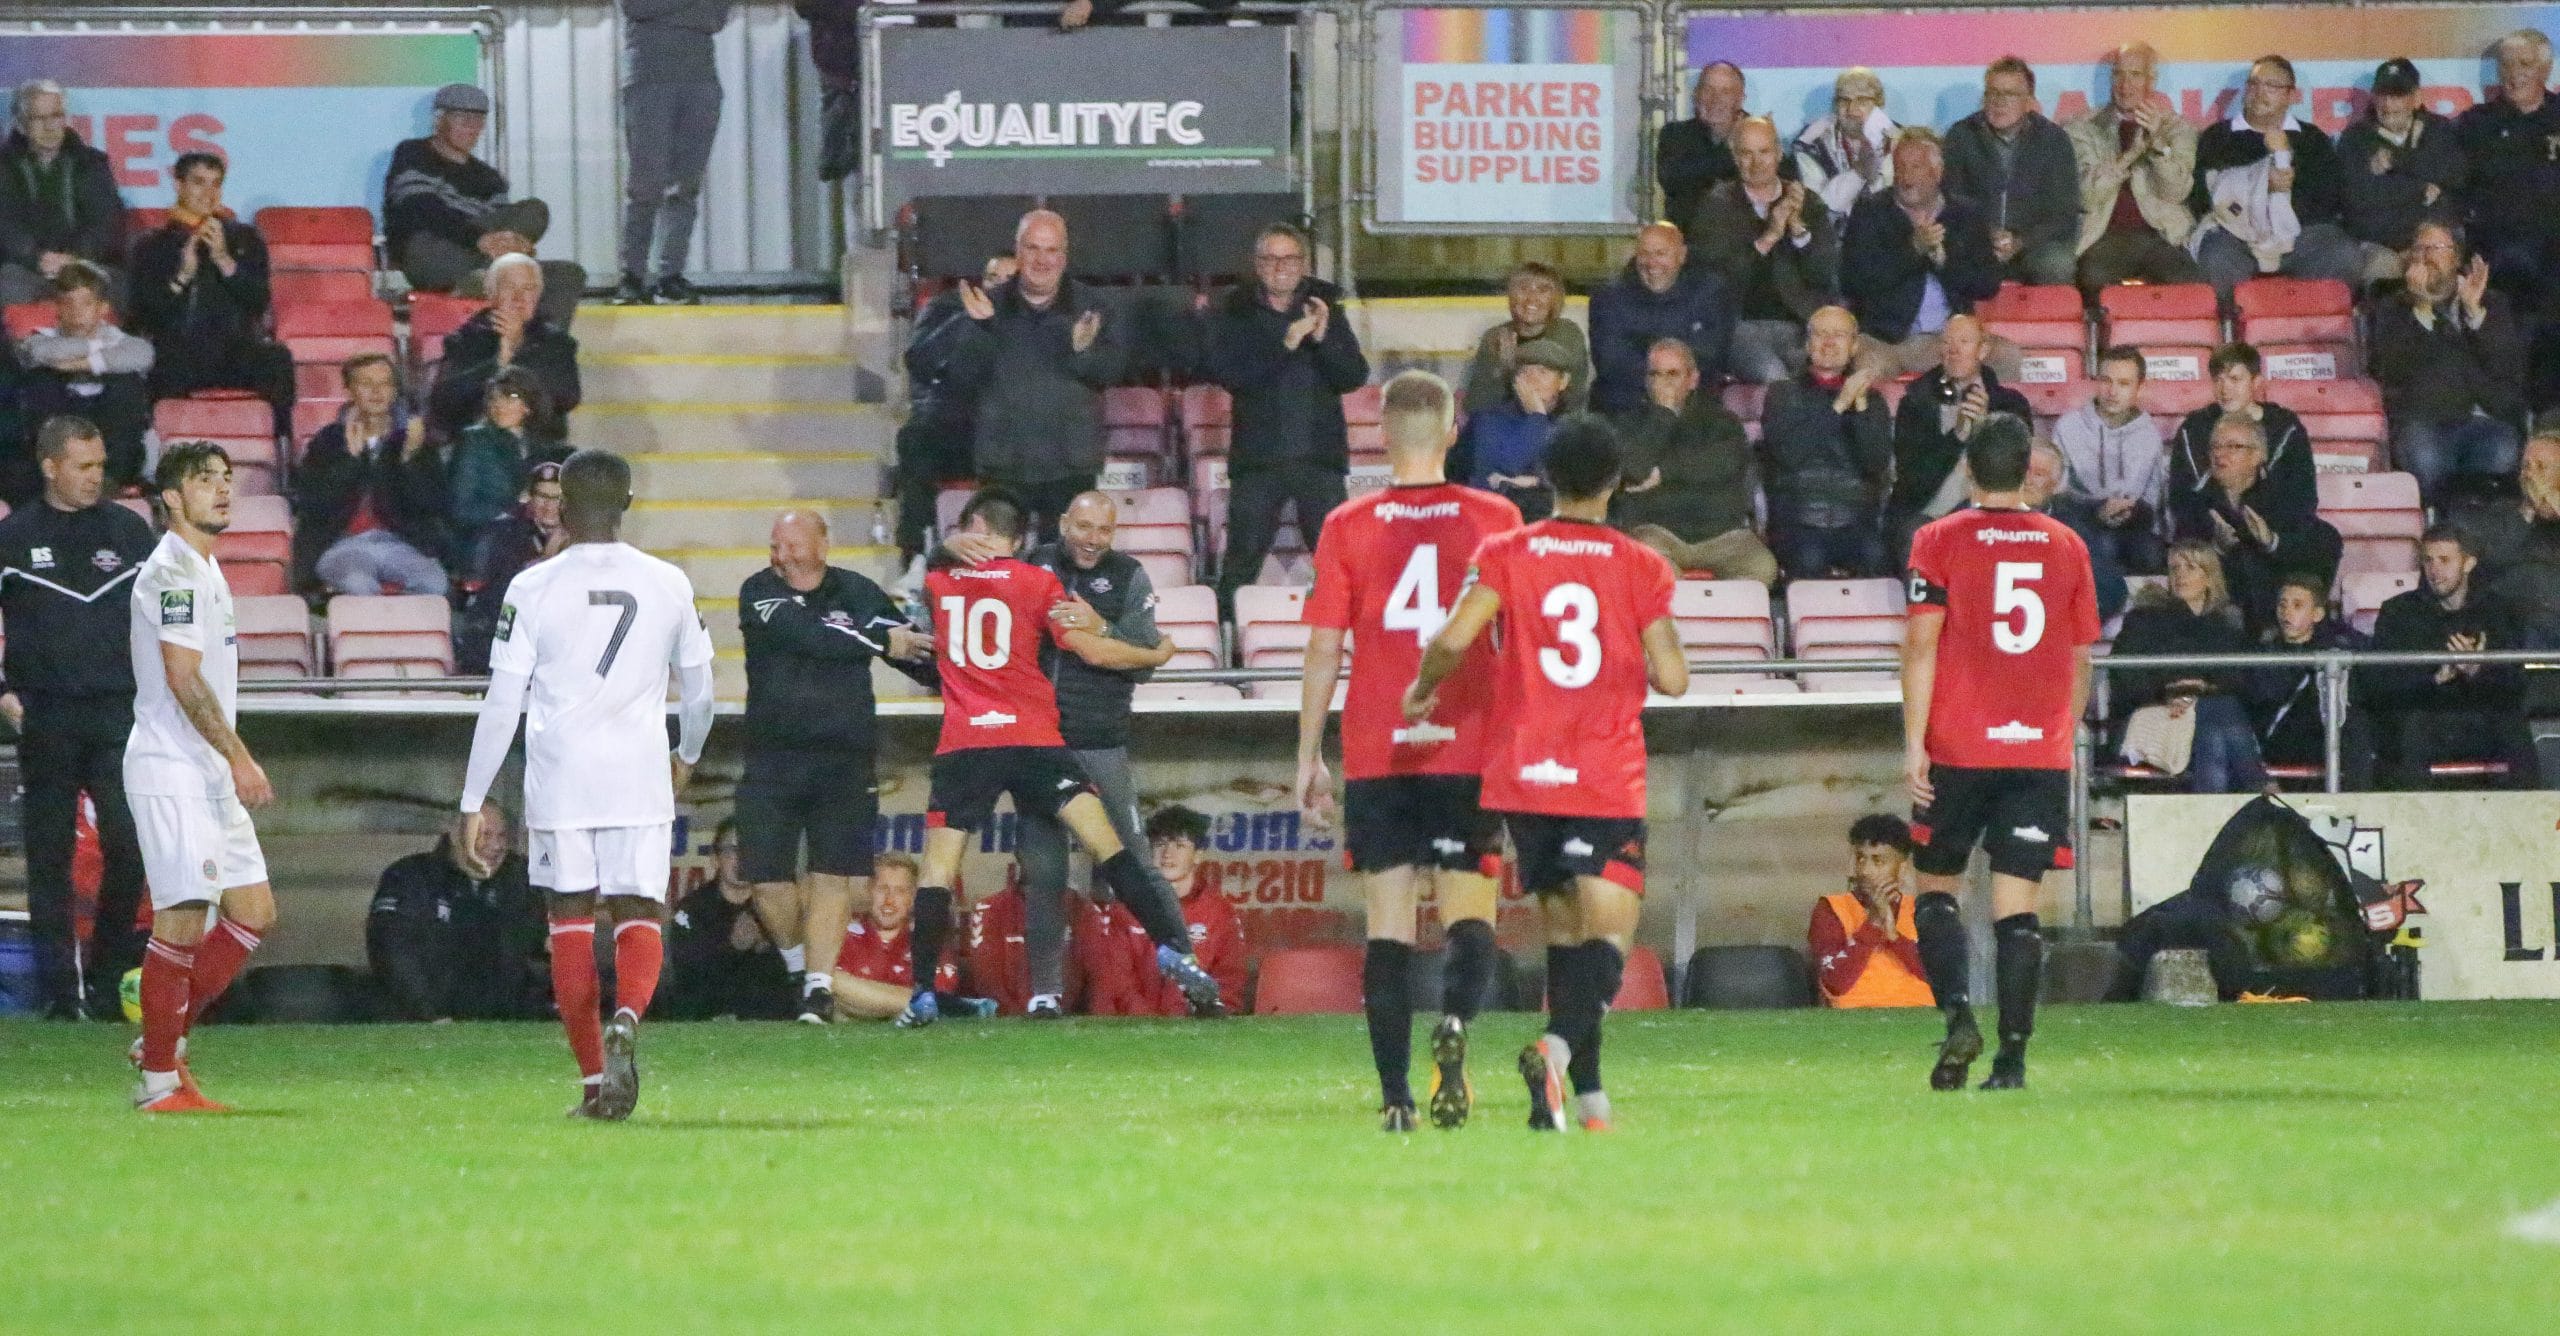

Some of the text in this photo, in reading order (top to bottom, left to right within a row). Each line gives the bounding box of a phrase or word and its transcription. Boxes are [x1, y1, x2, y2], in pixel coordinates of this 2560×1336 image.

[1415, 82, 1600, 117] PARKER
[890, 91, 1206, 167] EQUALITYFC
[1415, 121, 1601, 151] BUILDING
[1415, 155, 1601, 184] SUPPLIES
[2284, 357, 2319, 366] HOME
[1349, 474, 1392, 487] SPONS
[1383, 543, 1449, 648] 4
[1909, 578, 1927, 602] C
[1991, 561, 2046, 654] 5
[588, 590, 638, 680] 7
[940, 596, 1013, 670] 10
[1537, 582, 1602, 689] 3
